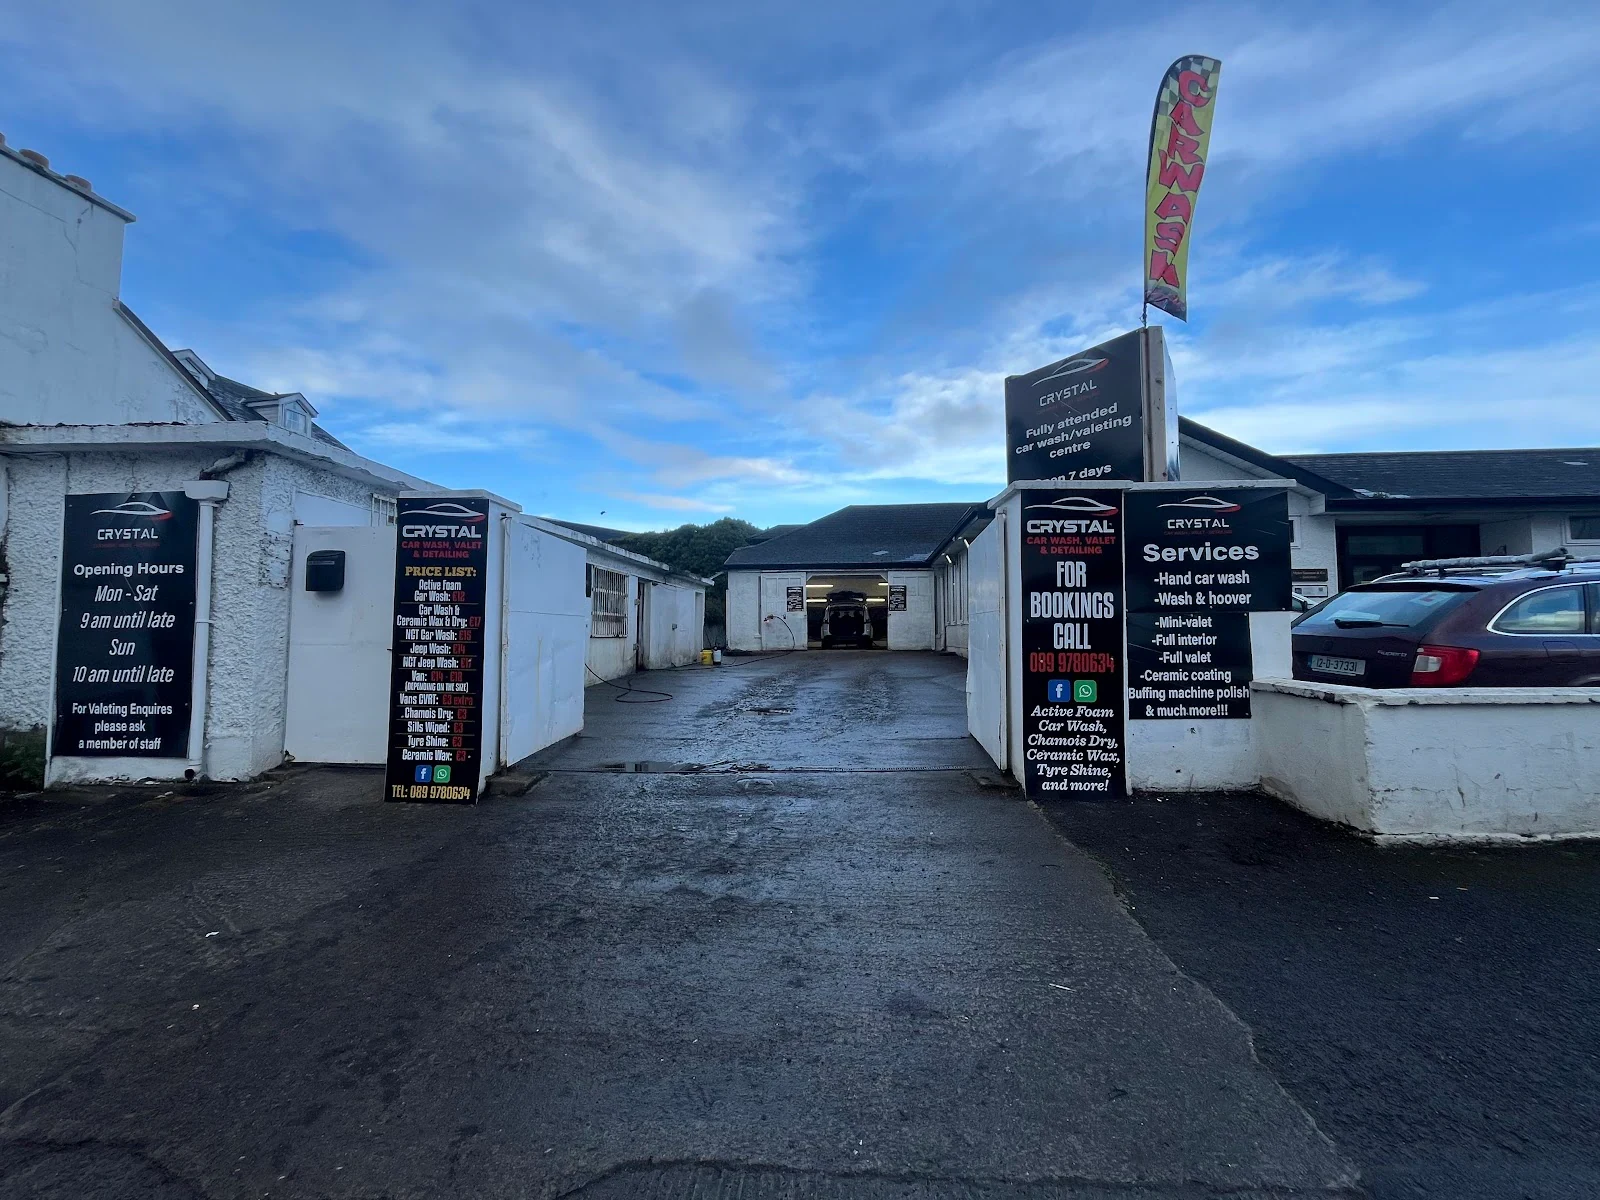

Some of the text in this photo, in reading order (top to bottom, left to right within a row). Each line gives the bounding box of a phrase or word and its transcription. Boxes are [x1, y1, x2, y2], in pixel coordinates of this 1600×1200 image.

[1039, 379, 1098, 407] CRYSTAL
[1026, 423, 1055, 439] Fully
[1057, 402, 1118, 430] attended
[1015, 415, 1133, 454] car wash/valeting
[1049, 441, 1091, 459] centre
[1068, 471, 1077, 480] 7
[1079, 465, 1112, 479] days
[1026, 519, 1115, 534] CRYSTAL
[1167, 518, 1230, 529] CRYSTAL
[97, 528, 158, 540] CRYSTAL
[402, 525, 482, 538] CRYSTAL
[402, 541, 482, 549] CAR WASH, VALET
[1026, 536, 1116, 546] CAR WASH, VALET
[1040, 546, 1103, 555] & DETAILING
[1143, 542, 1260, 562] Services
[73, 562, 184, 578] Opening Hours
[405, 566, 477, 576] PRICE LIST:
[1056, 561, 1087, 588] FOR
[419, 579, 462, 590] Active Foam
[1154, 570, 1250, 586] -Hand car wash
[95, 585, 122, 601] Mon
[134, 584, 159, 601] Sat
[414, 590, 428, 602] Car
[429, 590, 451, 602] Wash:
[1154, 591, 1251, 606] -Wash & hoover
[419, 604, 460, 615] Car Wash &
[1030, 591, 1114, 619] BOOKINGS
[113, 611, 146, 629] until
[147, 611, 175, 629] late
[396, 615, 427, 626] Ceramic
[428, 616, 444, 626] Wax
[445, 616, 450, 626] &
[451, 616, 468, 628] Dry:
[1154, 616, 1212, 628] -Mini-valet
[405, 629, 419, 640] NCT
[420, 629, 434, 640] Car
[435, 629, 457, 640] Wash:
[1053, 623, 1092, 649] CALL
[1152, 633, 1217, 646] -Full interior
[109, 638, 135, 655] Sun
[410, 643, 428, 655] Jeep
[429, 643, 451, 654] Wash:
[403, 656, 417, 667] NCT
[418, 657, 435, 669] Jeep
[436, 657, 458, 668] Wash:
[1030, 652, 1115, 673] 089 9780634
[1158, 651, 1211, 664] -Full valet
[112, 665, 146, 682] until
[147, 665, 174, 682] late
[412, 670, 427, 681] Van:
[1139, 669, 1232, 683] -Ceramic coating
[405, 681, 468, 692] (DEPENDING ON THE SIZE)
[400, 693, 417, 704] Vans
[418, 694, 439, 705] CVRT:
[1128, 686, 1250, 701] Buffing machine polish
[72, 703, 172, 718] For Valeting Enquires
[404, 707, 436, 719] Chamois
[438, 708, 453, 720] Dry:
[1031, 705, 1114, 718] Active Foam
[1145, 704, 1228, 717] & much more!!!
[94, 720, 146, 734] please ask
[407, 721, 423, 732] Sills
[425, 722, 450, 734] Wiped:
[1038, 720, 1107, 734] Car Wash,
[78, 737, 161, 749] a member of staff
[407, 735, 424, 748] Tyre
[425, 735, 448, 746] Shine:
[1028, 734, 1118, 749] Chamois Dry,
[402, 749, 433, 760] Ceramic
[434, 749, 452, 761] Wax:
[1027, 749, 1120, 763] Ceramic Wax,
[1037, 763, 1112, 778] Tyre Shine,
[1042, 779, 1109, 791] and more!
[392, 784, 470, 800] TEL: 089 9780634
